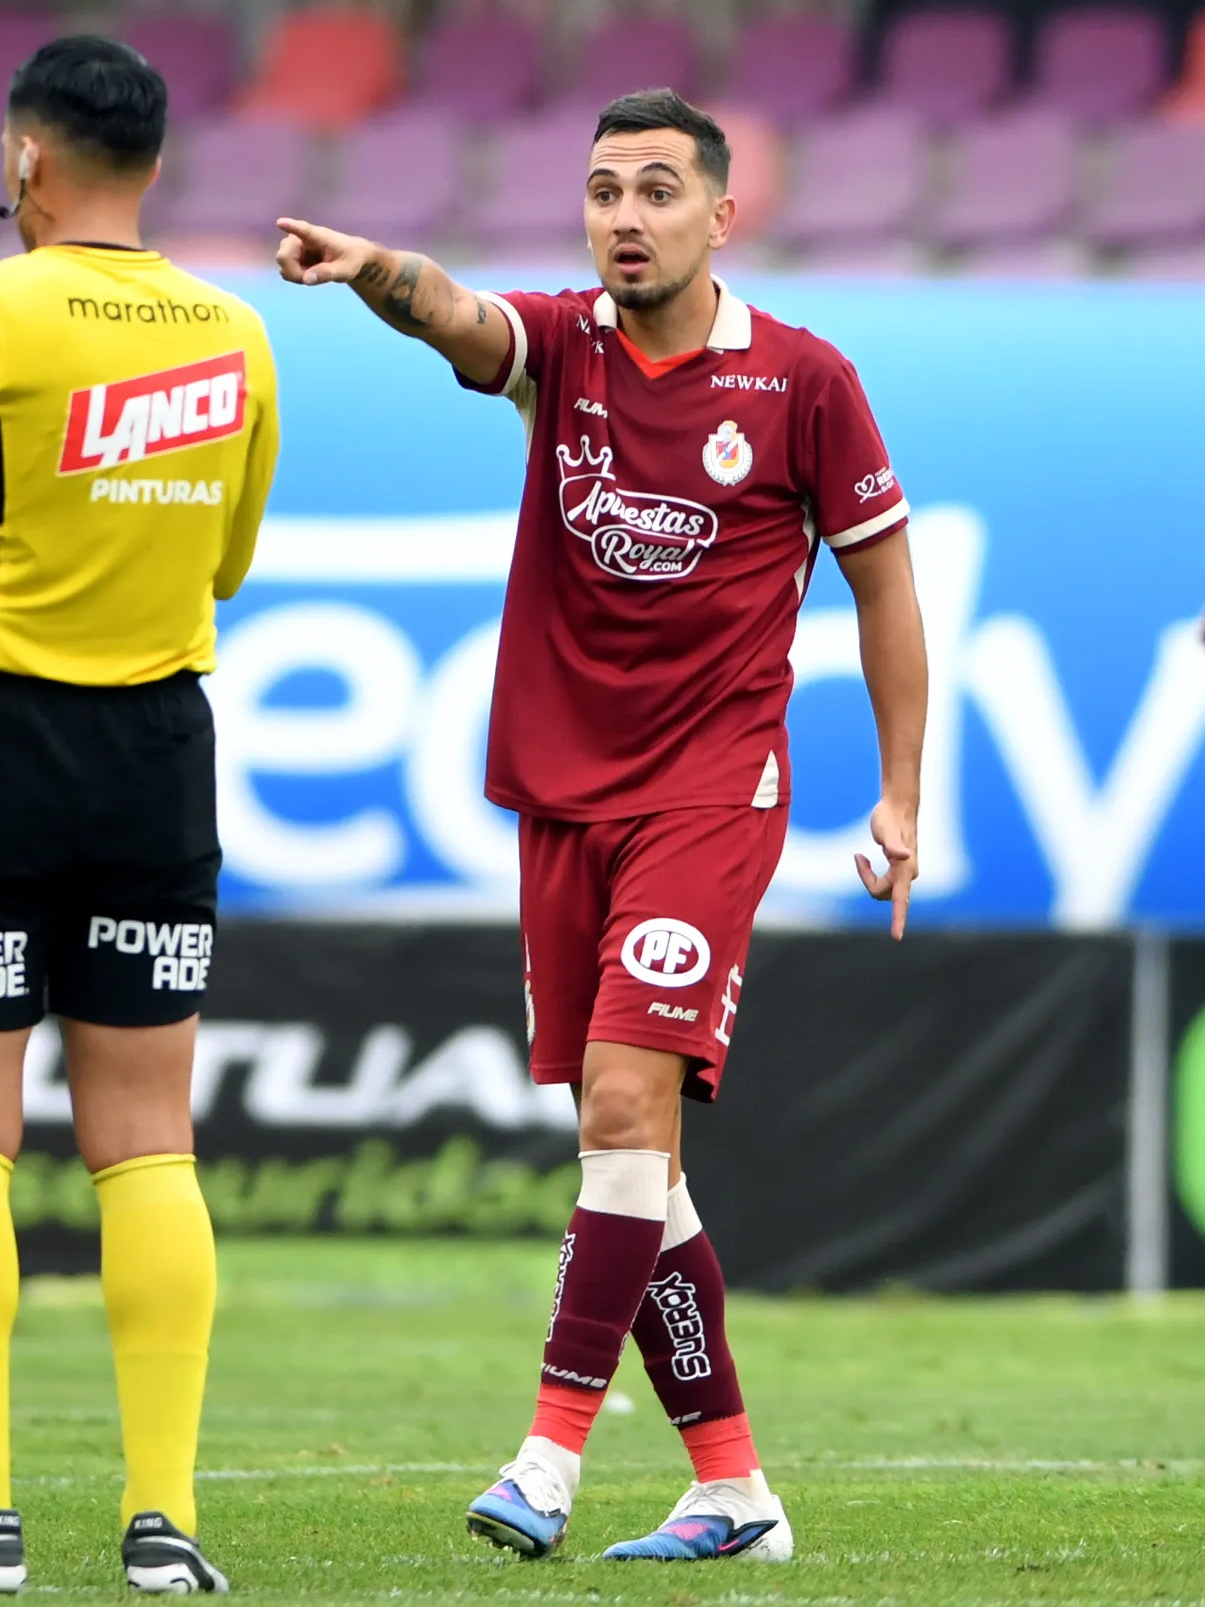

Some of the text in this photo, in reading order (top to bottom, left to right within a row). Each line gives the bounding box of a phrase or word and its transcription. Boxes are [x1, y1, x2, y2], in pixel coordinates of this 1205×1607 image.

[68, 297, 230, 324] marathon
[81, 371, 239, 469] LANCO
[90, 478, 224, 505] PINTURAS
[567, 480, 705, 536] Apuestas
[601, 530, 695, 574] Royal
[649, 561, 682, 572] .COM
[88, 916, 214, 957] POWER
[639, 930, 692, 975] PF
[152, 956, 211, 991] ADE
[647, 1001, 699, 1022] FIUME
[134, 1517, 162, 1529] KING
